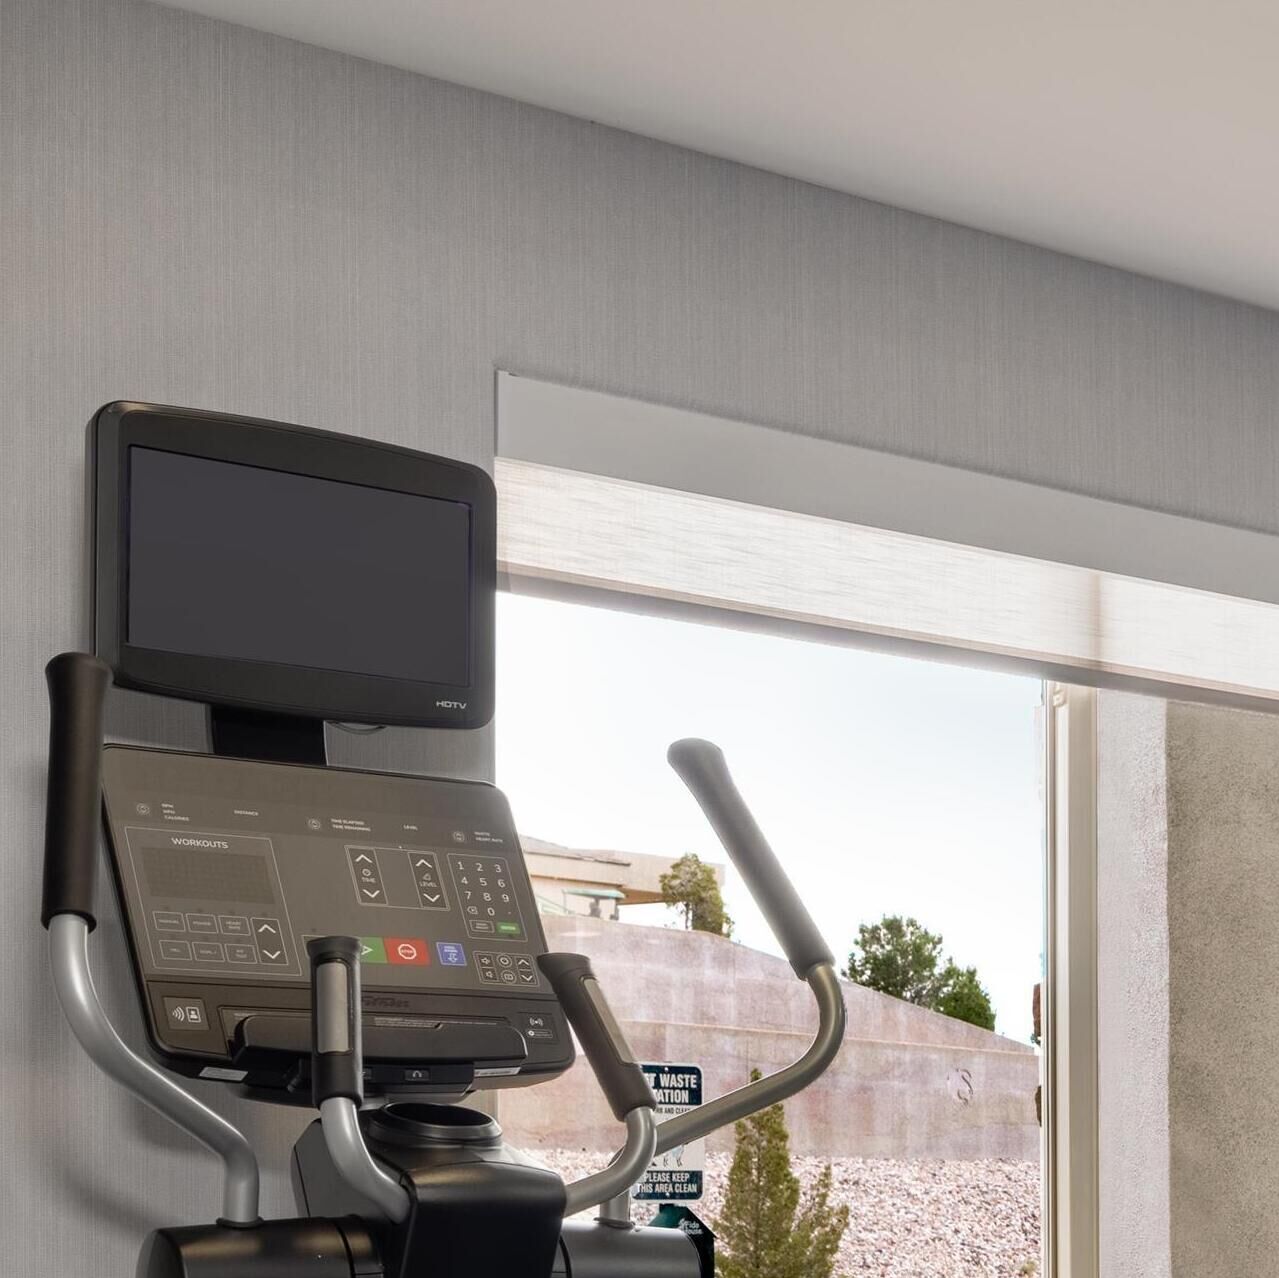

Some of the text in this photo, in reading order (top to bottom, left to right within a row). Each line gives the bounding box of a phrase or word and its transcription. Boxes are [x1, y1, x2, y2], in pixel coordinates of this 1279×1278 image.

[436, 700, 467, 709] HDTV
[171, 837, 229, 849] WORKOUTS
[458, 861, 502, 873] 1 2 3
[461, 876, 506, 888] 4 5 6
[464, 891, 510, 903] 7 8 9
[487, 907, 495, 916] 0
[660, 1073, 697, 1088] WASTE
[653, 1089, 689, 1104] TATION
[645, 1172, 690, 1182] PLEASE KEEP
[638, 1183, 698, 1193] THIS AREA CLEAN
